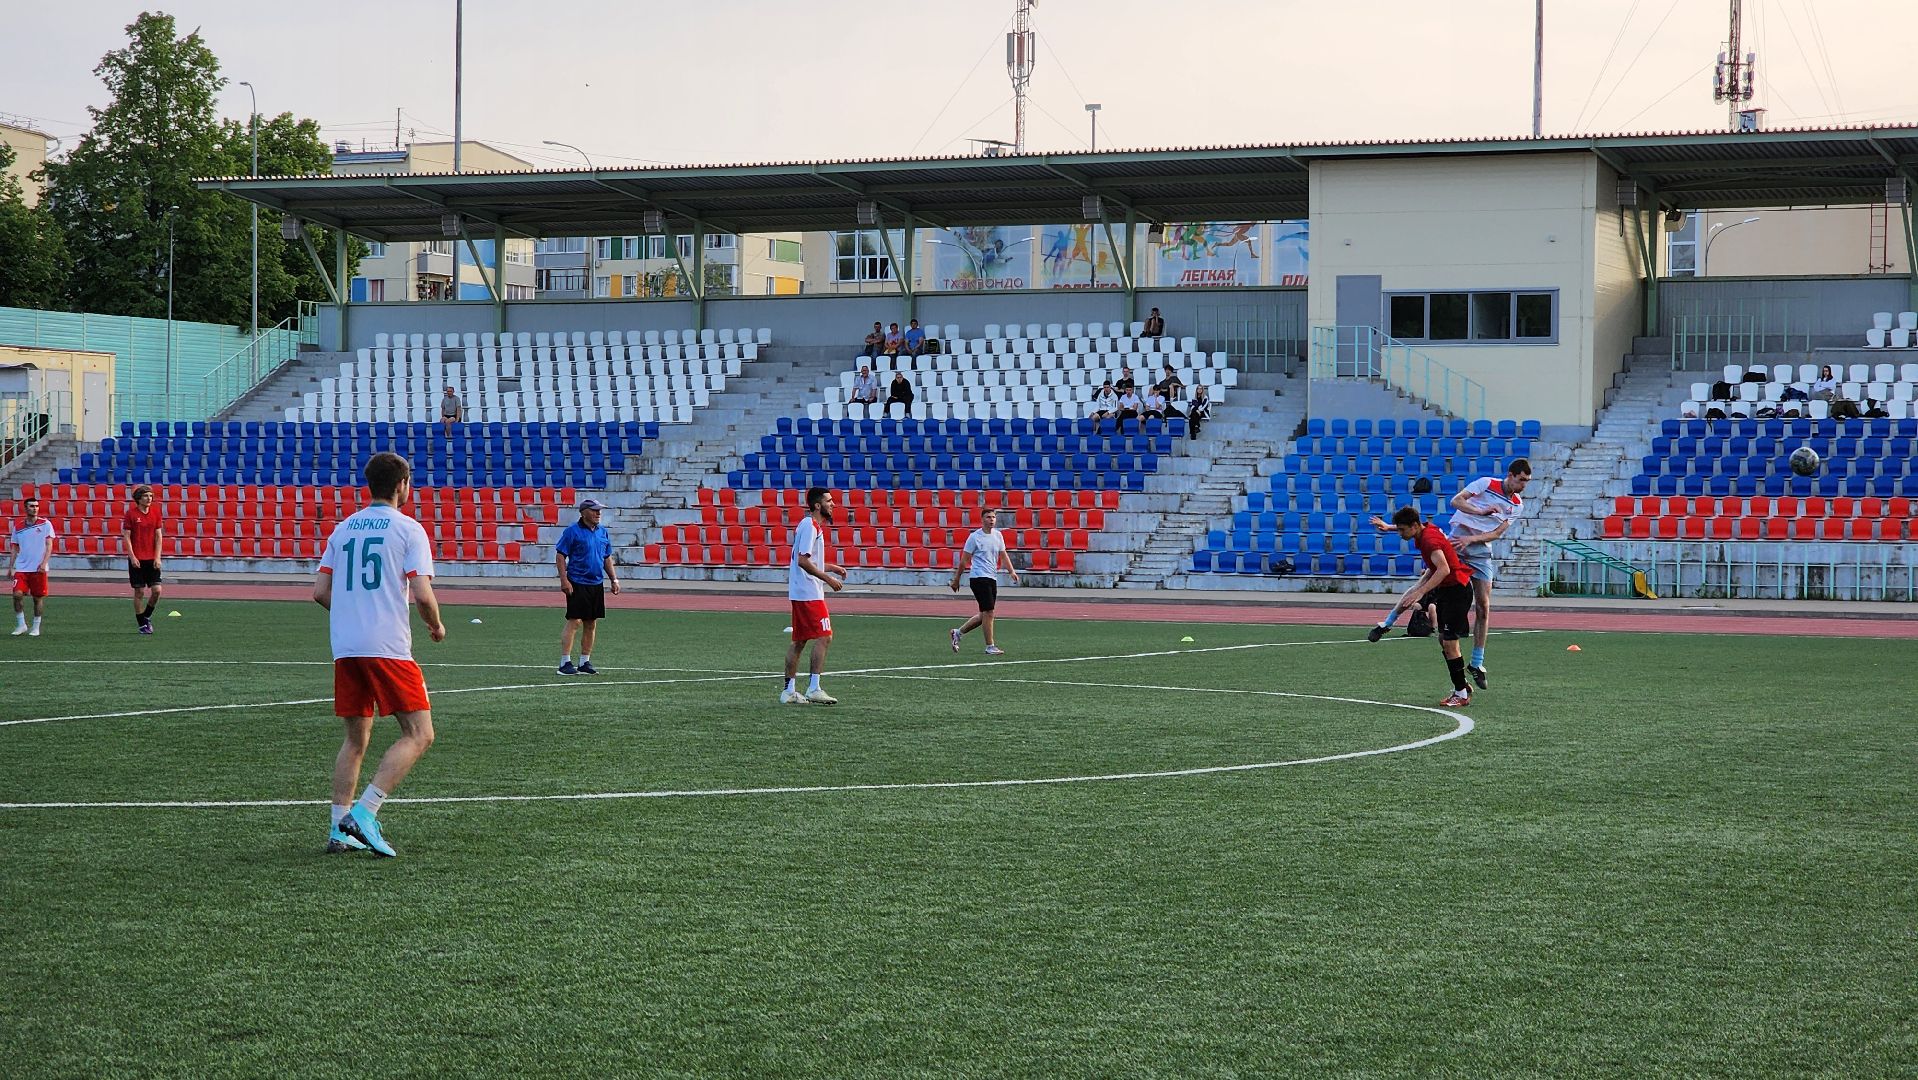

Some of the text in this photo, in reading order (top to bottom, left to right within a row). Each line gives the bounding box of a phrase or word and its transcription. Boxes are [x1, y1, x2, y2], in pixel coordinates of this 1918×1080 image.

[1181, 269, 1235, 281] ЛЕГКАЯ
[347, 518, 390, 530] НЫРКОВ
[342, 537, 384, 591] 15
[820, 618, 831, 631] 10
